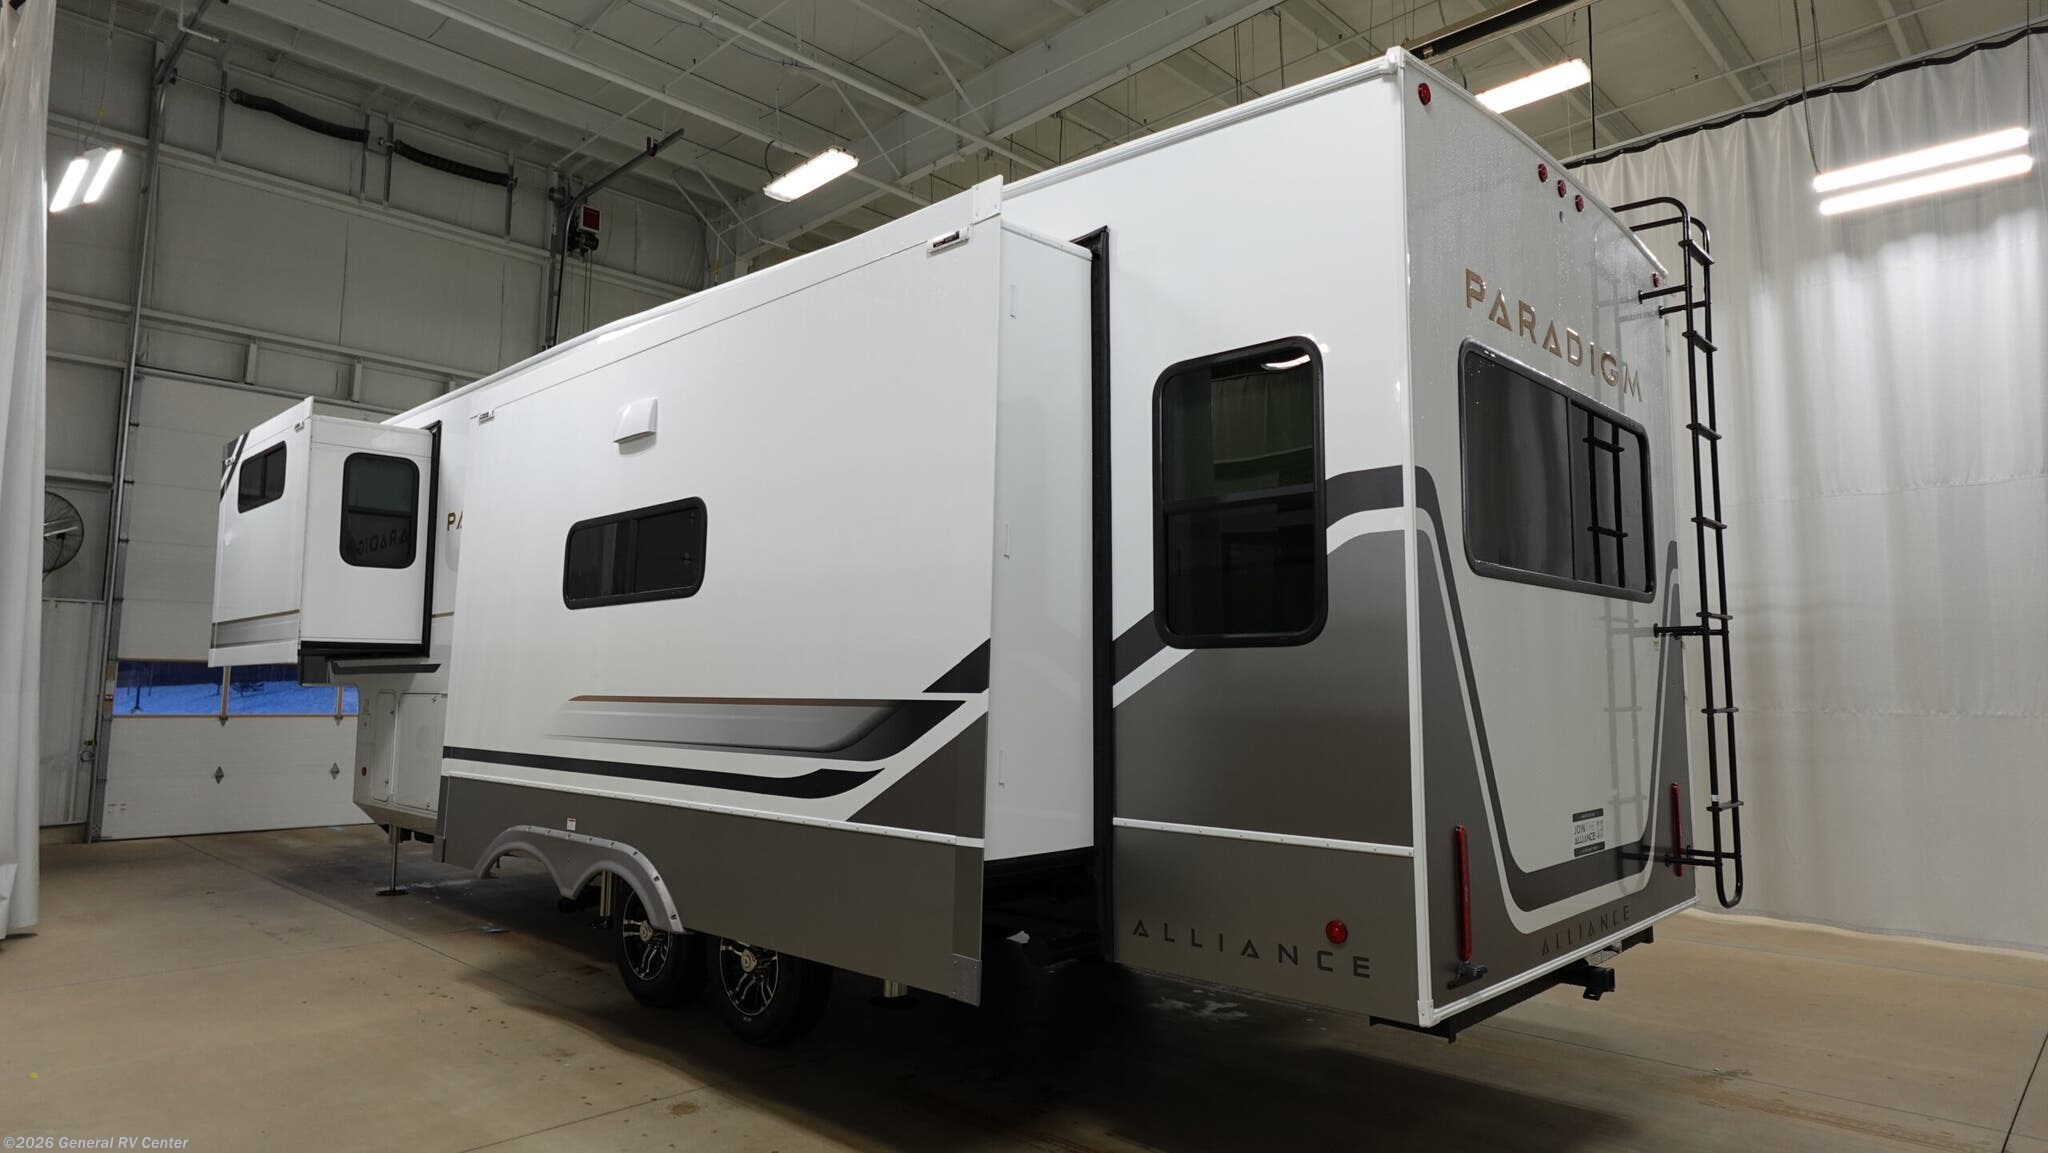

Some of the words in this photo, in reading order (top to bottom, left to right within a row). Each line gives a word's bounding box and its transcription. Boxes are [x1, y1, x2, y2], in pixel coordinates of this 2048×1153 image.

[1465, 267, 1642, 402] PARADIGM
[1574, 823, 1586, 835] JOIN
[1574, 832, 1596, 845] ALLIANCE
[1133, 920, 1371, 979] ALLIANCE
[1542, 904, 1630, 957] ALLIANCE
